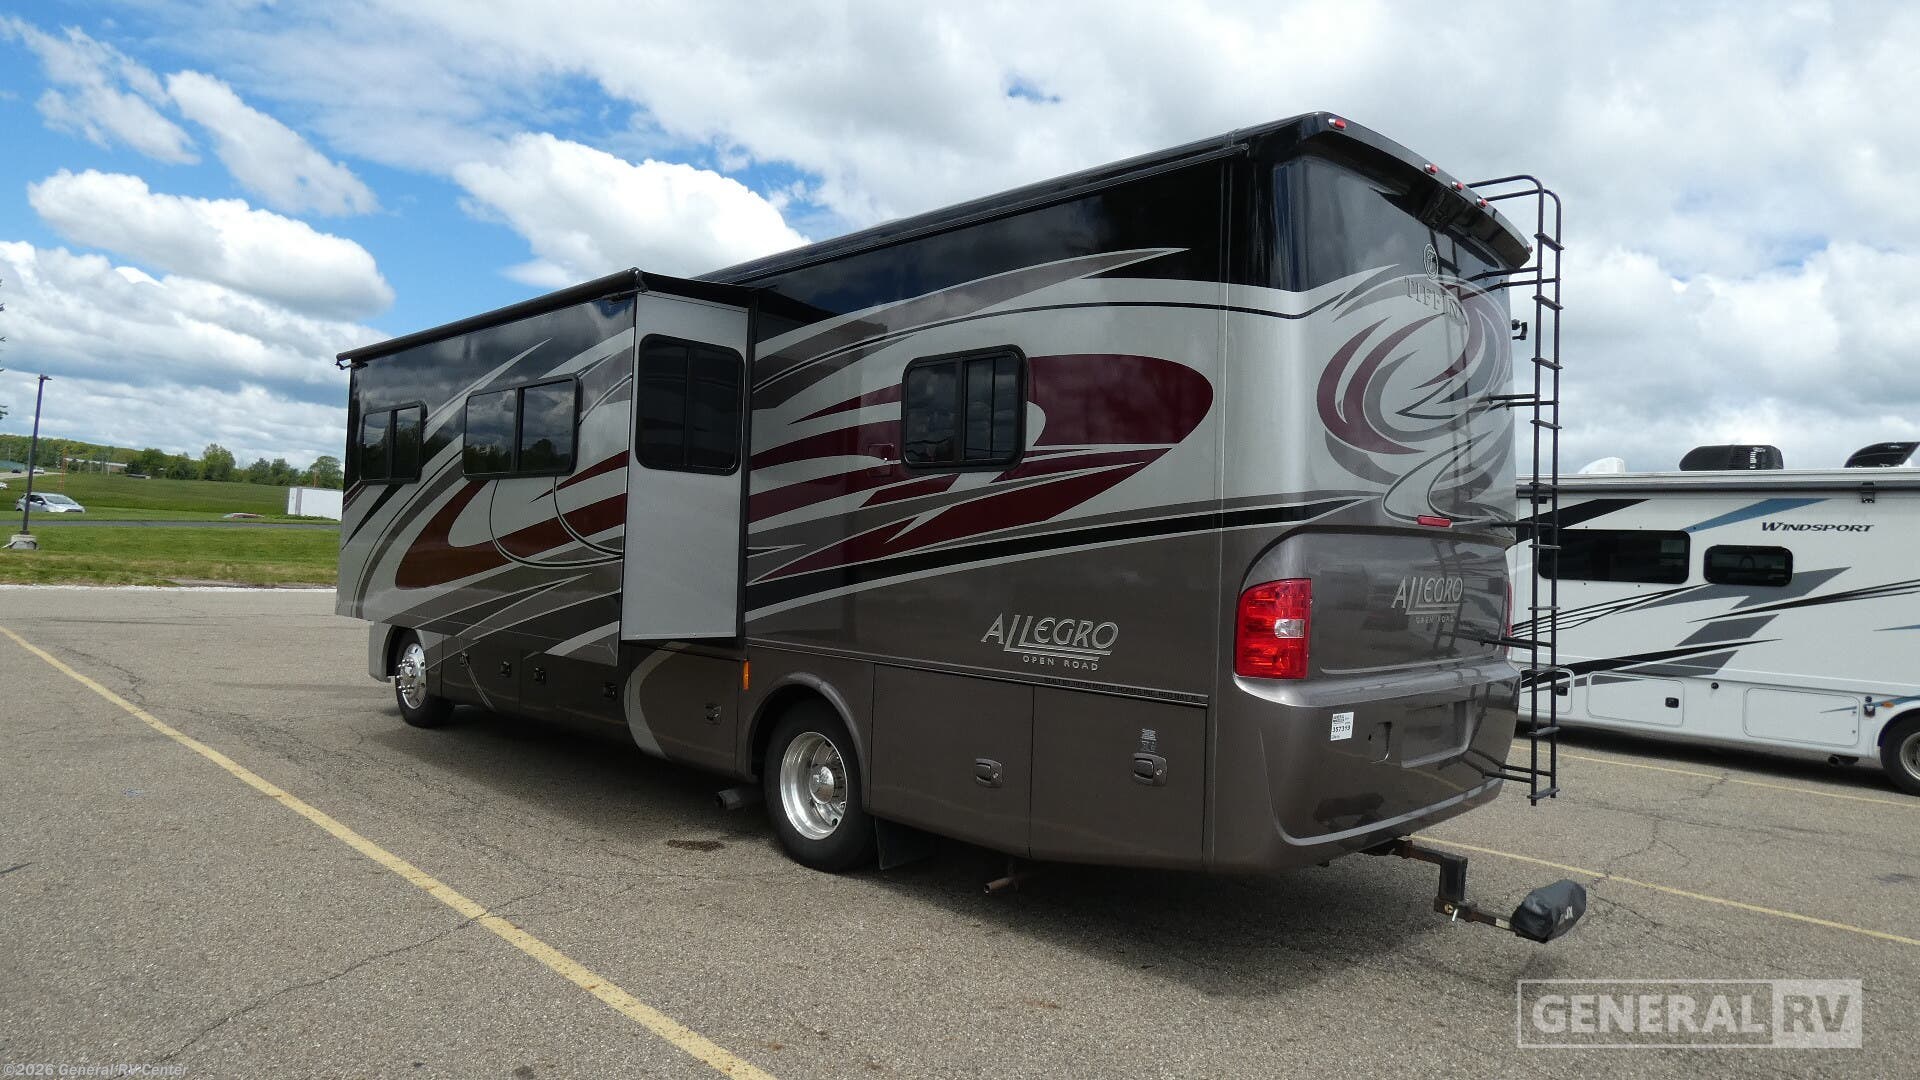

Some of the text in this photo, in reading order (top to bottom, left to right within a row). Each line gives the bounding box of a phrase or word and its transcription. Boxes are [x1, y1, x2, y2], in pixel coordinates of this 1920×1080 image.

[1762, 521, 1875, 532] WINDSPORT
[1390, 575, 1463, 615] ALLEGRO
[980, 612, 1119, 659] ALLEGRO
[1022, 655, 1098, 671] OPEN ROAD
